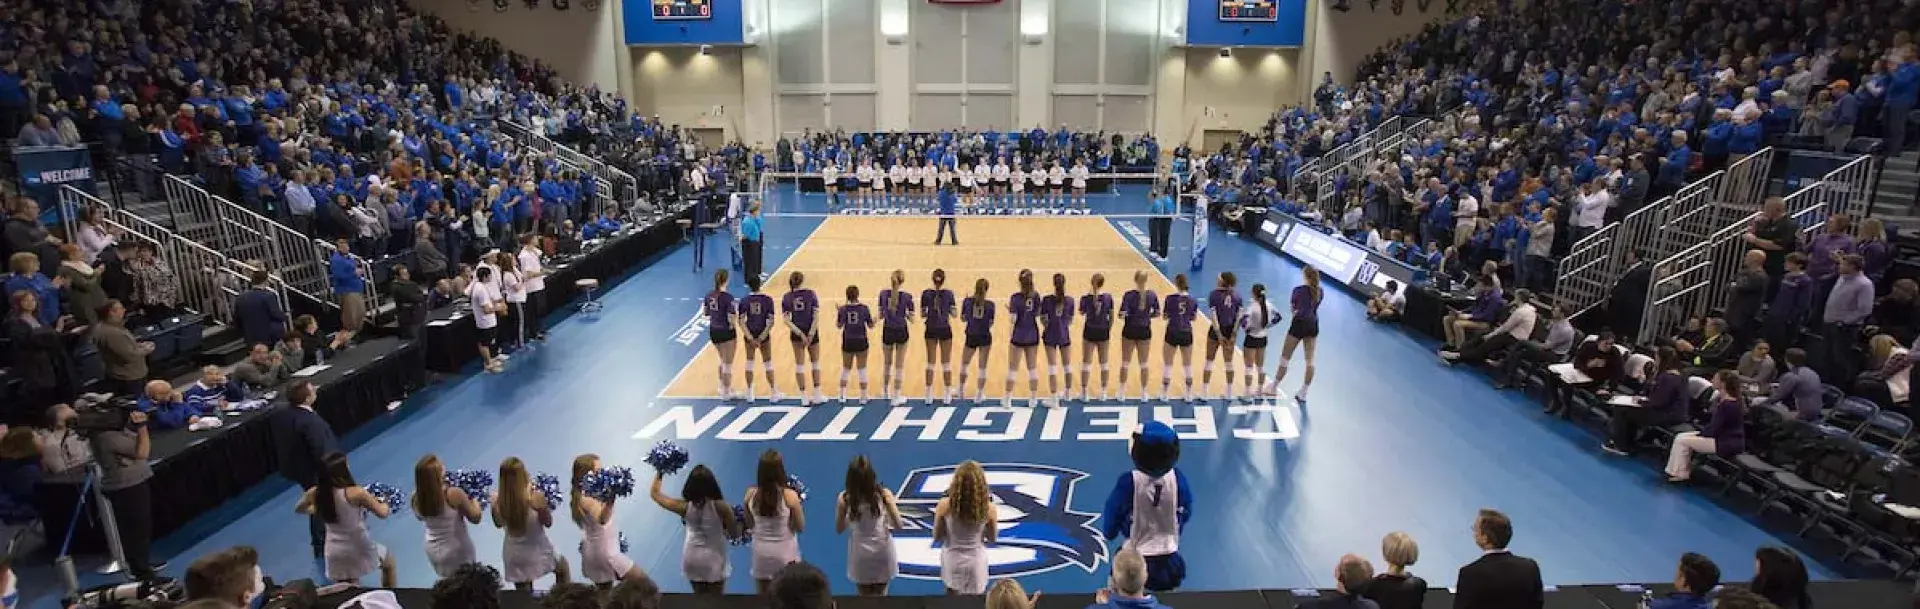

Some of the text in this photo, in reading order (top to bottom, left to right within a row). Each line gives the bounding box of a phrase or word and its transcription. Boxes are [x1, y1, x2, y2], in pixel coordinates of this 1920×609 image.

[701, 4, 709, 16] 0
[41, 167, 91, 184] WELCOME
[793, 297, 805, 311] 15
[1025, 297, 1033, 312] 9
[1178, 301, 1187, 315] 5
[1223, 294, 1232, 309] 4
[847, 311, 860, 325] 13
[631, 405, 1300, 441] CREIGHTON
